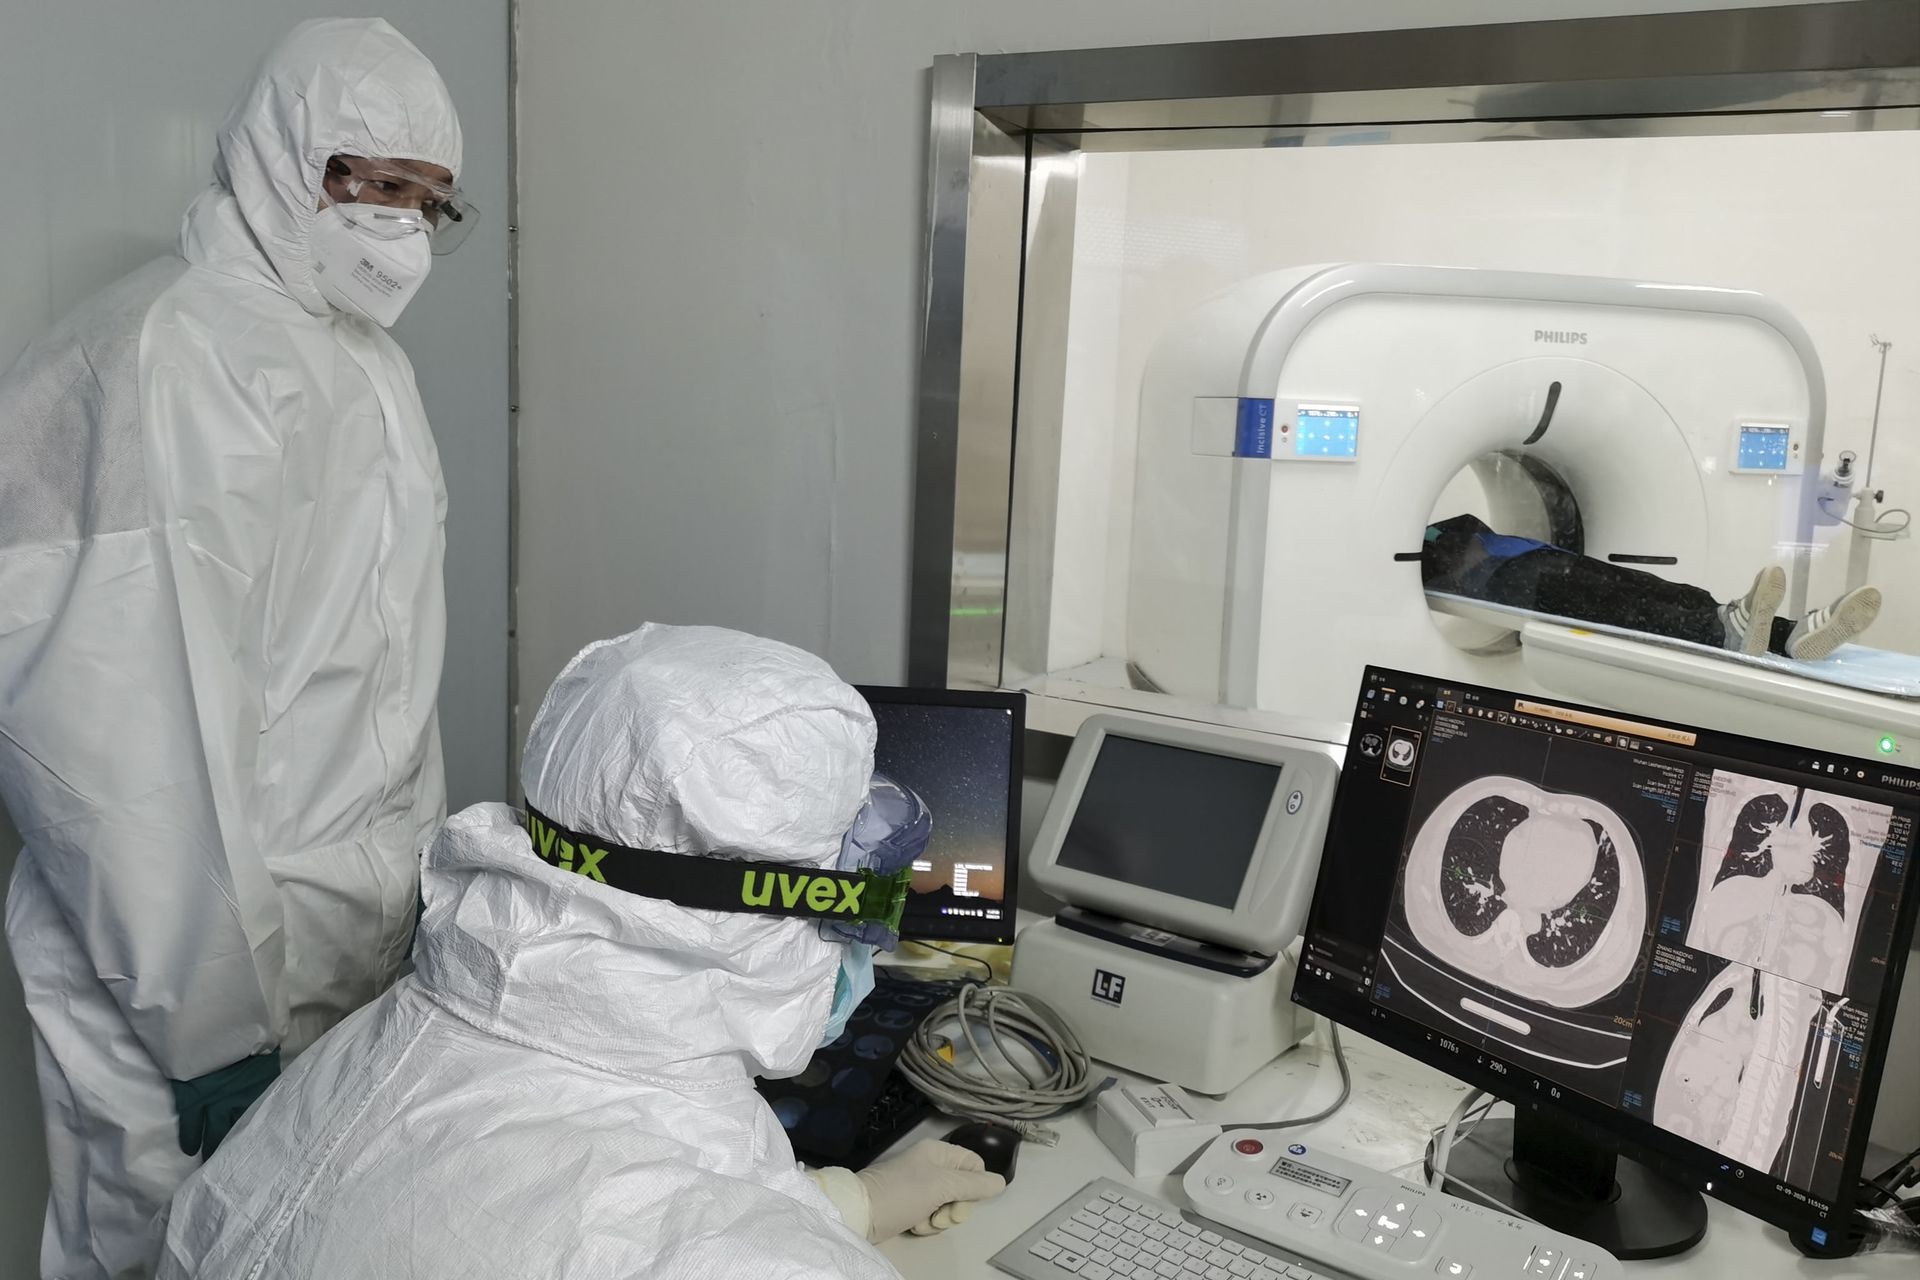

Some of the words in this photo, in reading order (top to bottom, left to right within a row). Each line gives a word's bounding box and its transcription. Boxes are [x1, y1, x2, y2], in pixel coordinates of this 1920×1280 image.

[360, 257, 374, 272] 3M
[1534, 329, 1588, 345] PHILIPS
[1256, 417, 1266, 454] Incisive
[1881, 774, 1920, 791] PHILIPS
[742, 870, 866, 914] uvex
[1613, 1015, 1633, 1029] 20cm
[1819, 1211, 1827, 1219] CT
